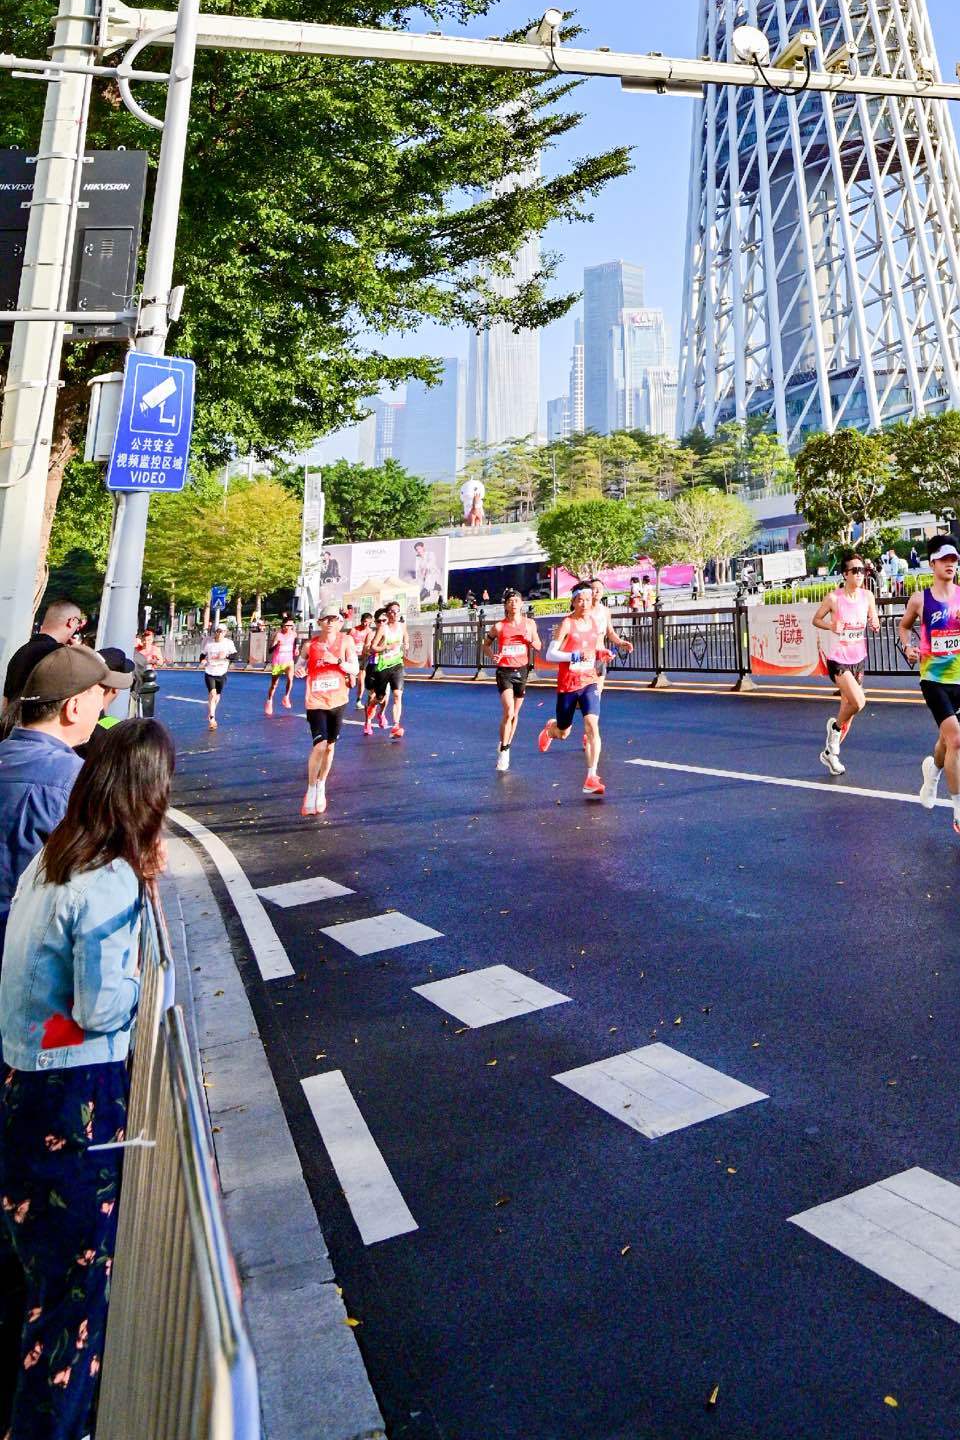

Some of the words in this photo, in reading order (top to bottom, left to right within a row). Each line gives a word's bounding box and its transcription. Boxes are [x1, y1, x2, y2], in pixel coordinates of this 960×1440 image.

[0, 183, 35, 191] IKVISIO
[83, 183, 131, 191] HIKVISION
[131, 437, 175, 453] 公共安全
[116, 453, 183, 471] 视频监控区域
[130, 471, 166, 484] VIDEO
